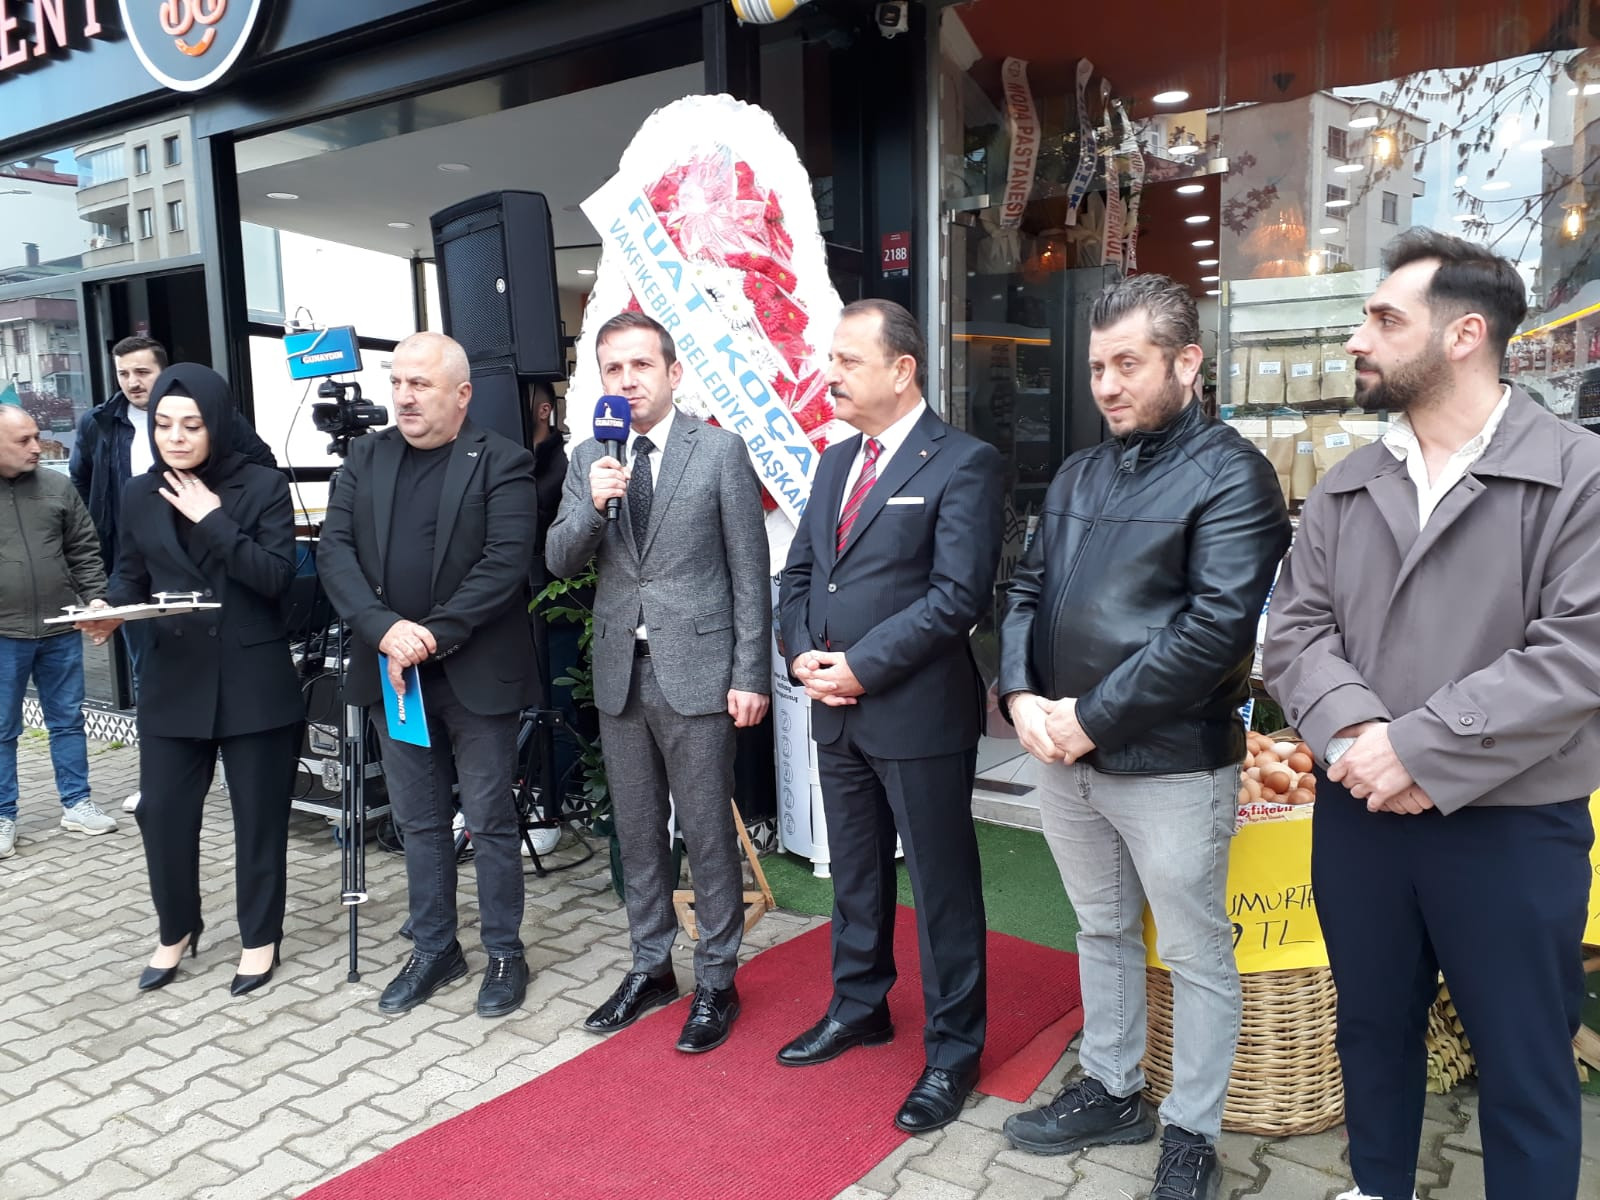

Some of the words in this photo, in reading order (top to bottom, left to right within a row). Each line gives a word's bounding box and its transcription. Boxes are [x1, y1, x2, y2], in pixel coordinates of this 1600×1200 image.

[1007, 82, 1031, 124] MODA
[609, 218, 682, 334] VAKFIKEBİR
[677, 333, 754, 434] BELEDİYE
[628, 196, 712, 313] FUAT
[713, 334, 813, 484] KOÇA
[1256, 919, 1316, 950] TL
